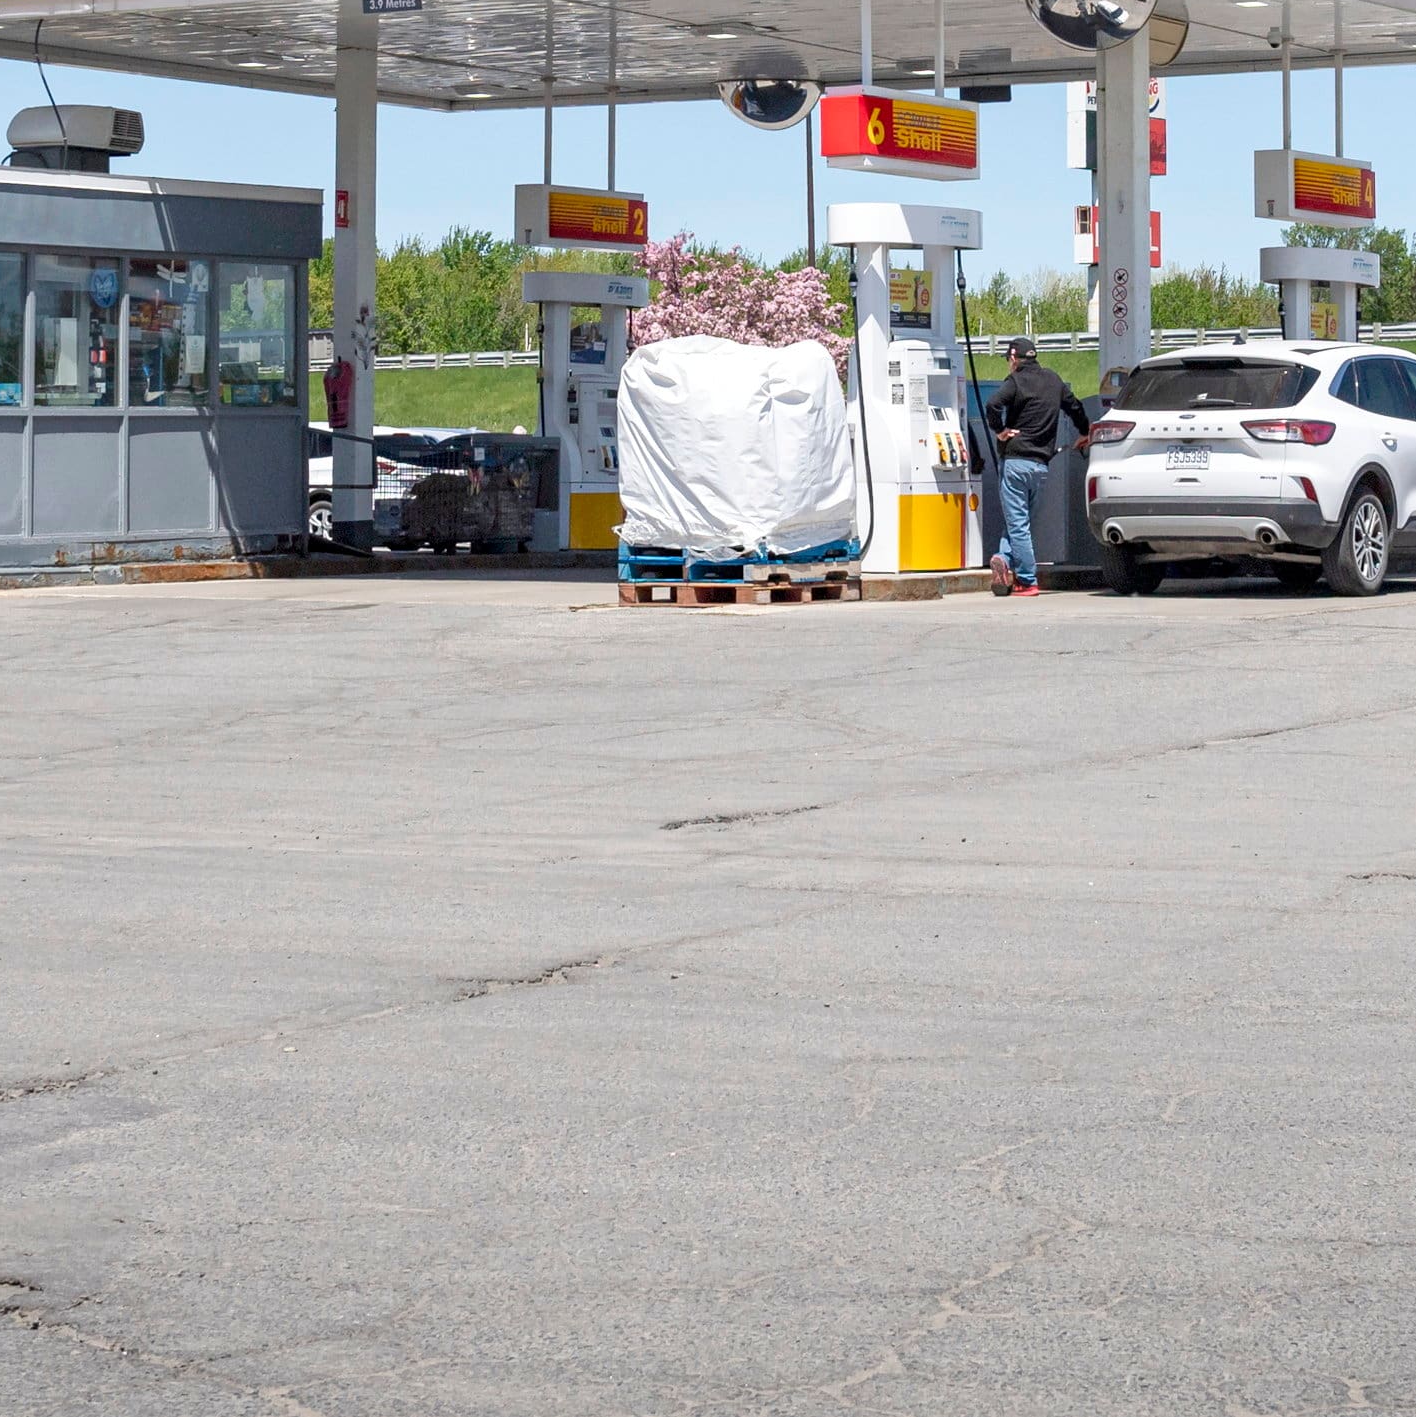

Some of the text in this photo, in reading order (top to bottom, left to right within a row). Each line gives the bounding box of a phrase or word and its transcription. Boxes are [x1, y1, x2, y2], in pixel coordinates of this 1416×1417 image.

[369, 0, 383, 9] 3.9
[867, 107, 885, 146] 6
[896, 128, 942, 151] Shell
[1332, 187, 1360, 206] Shell
[1364, 178, 1373, 209] 4
[593, 217, 627, 235] Shell
[633, 207, 644, 236] 2
